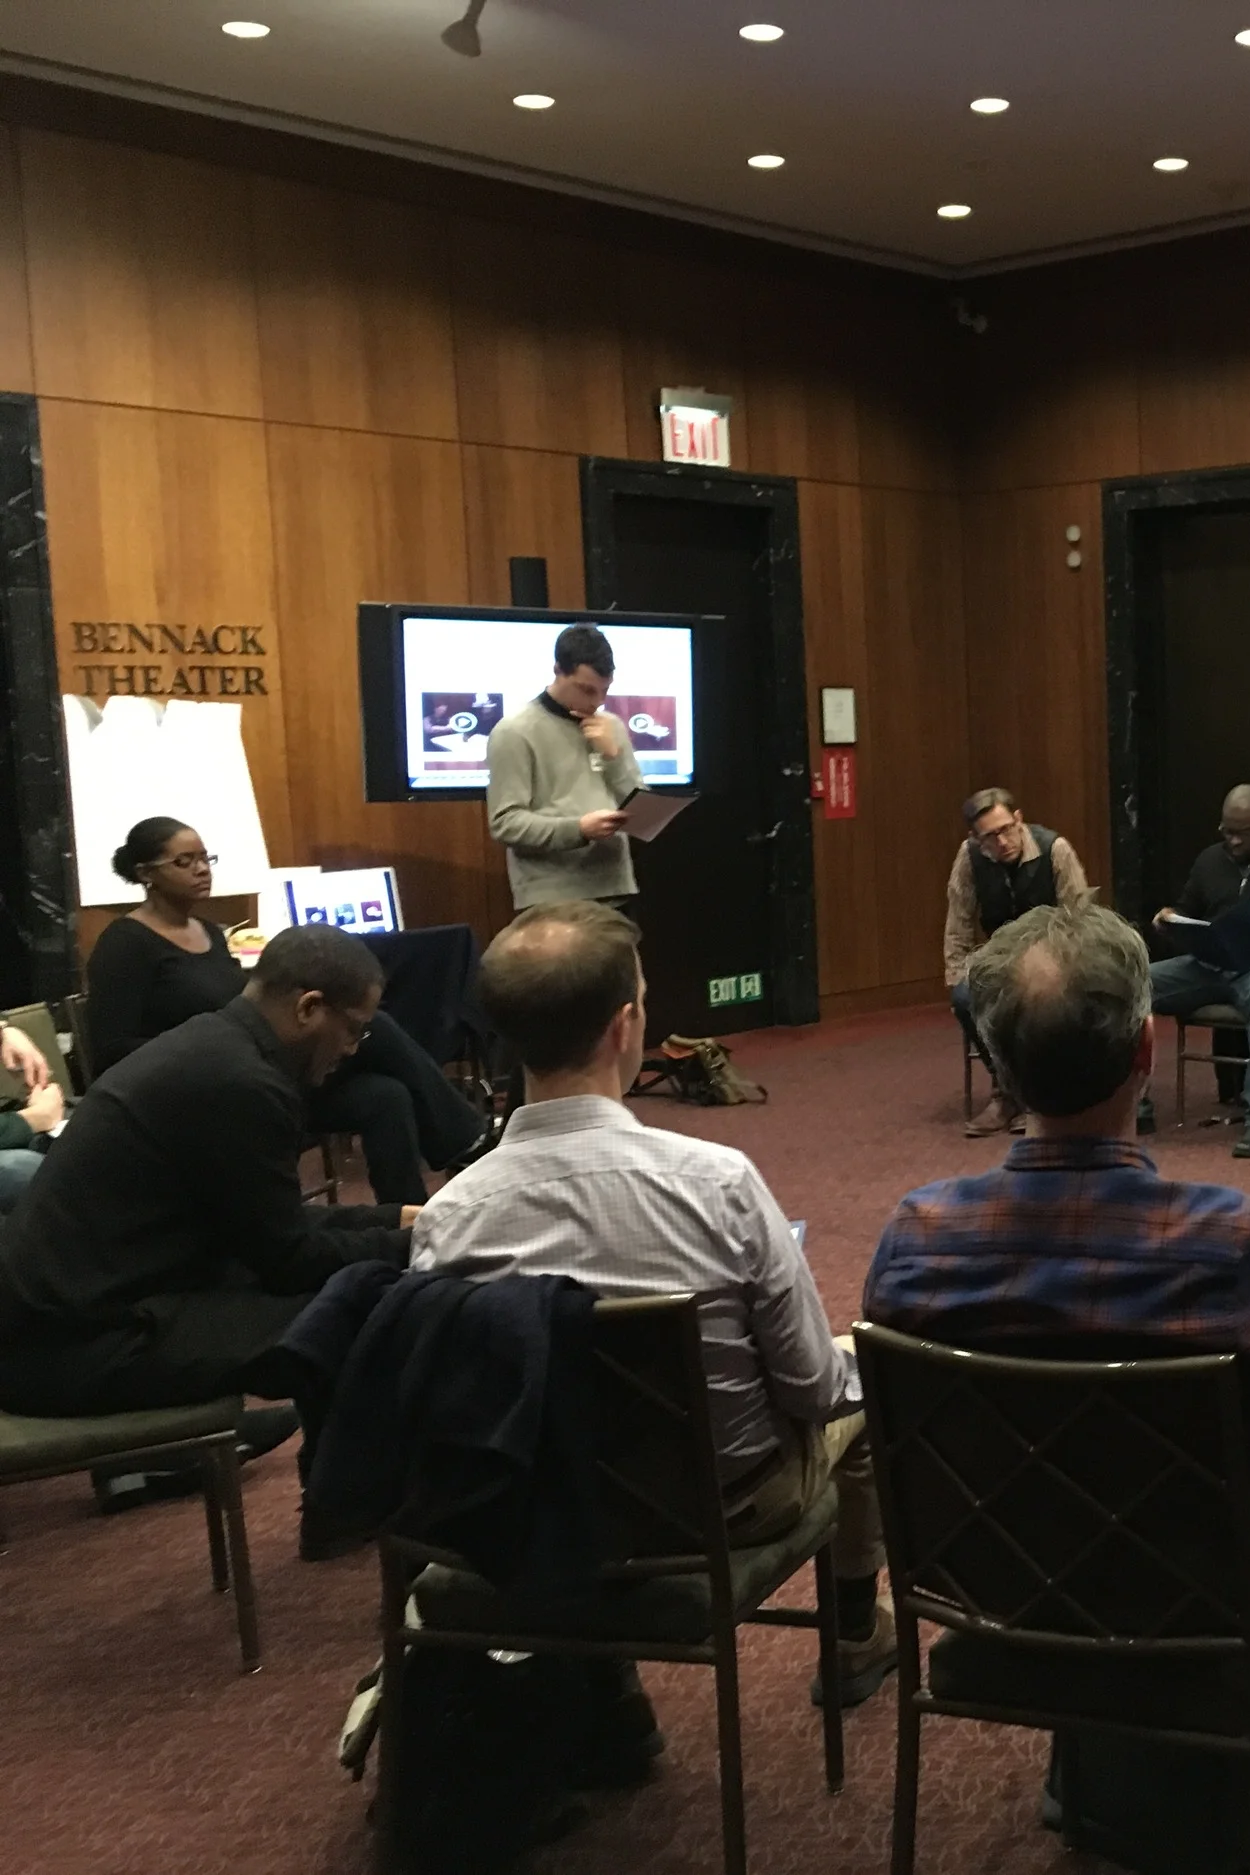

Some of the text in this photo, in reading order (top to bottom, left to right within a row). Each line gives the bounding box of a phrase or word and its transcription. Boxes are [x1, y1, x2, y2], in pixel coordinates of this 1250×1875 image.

[669, 412, 719, 461] EXIT
[70, 622, 267, 656] BENNACK
[74, 664, 269, 696] THEATER
[709, 977, 737, 1003] EXIT
